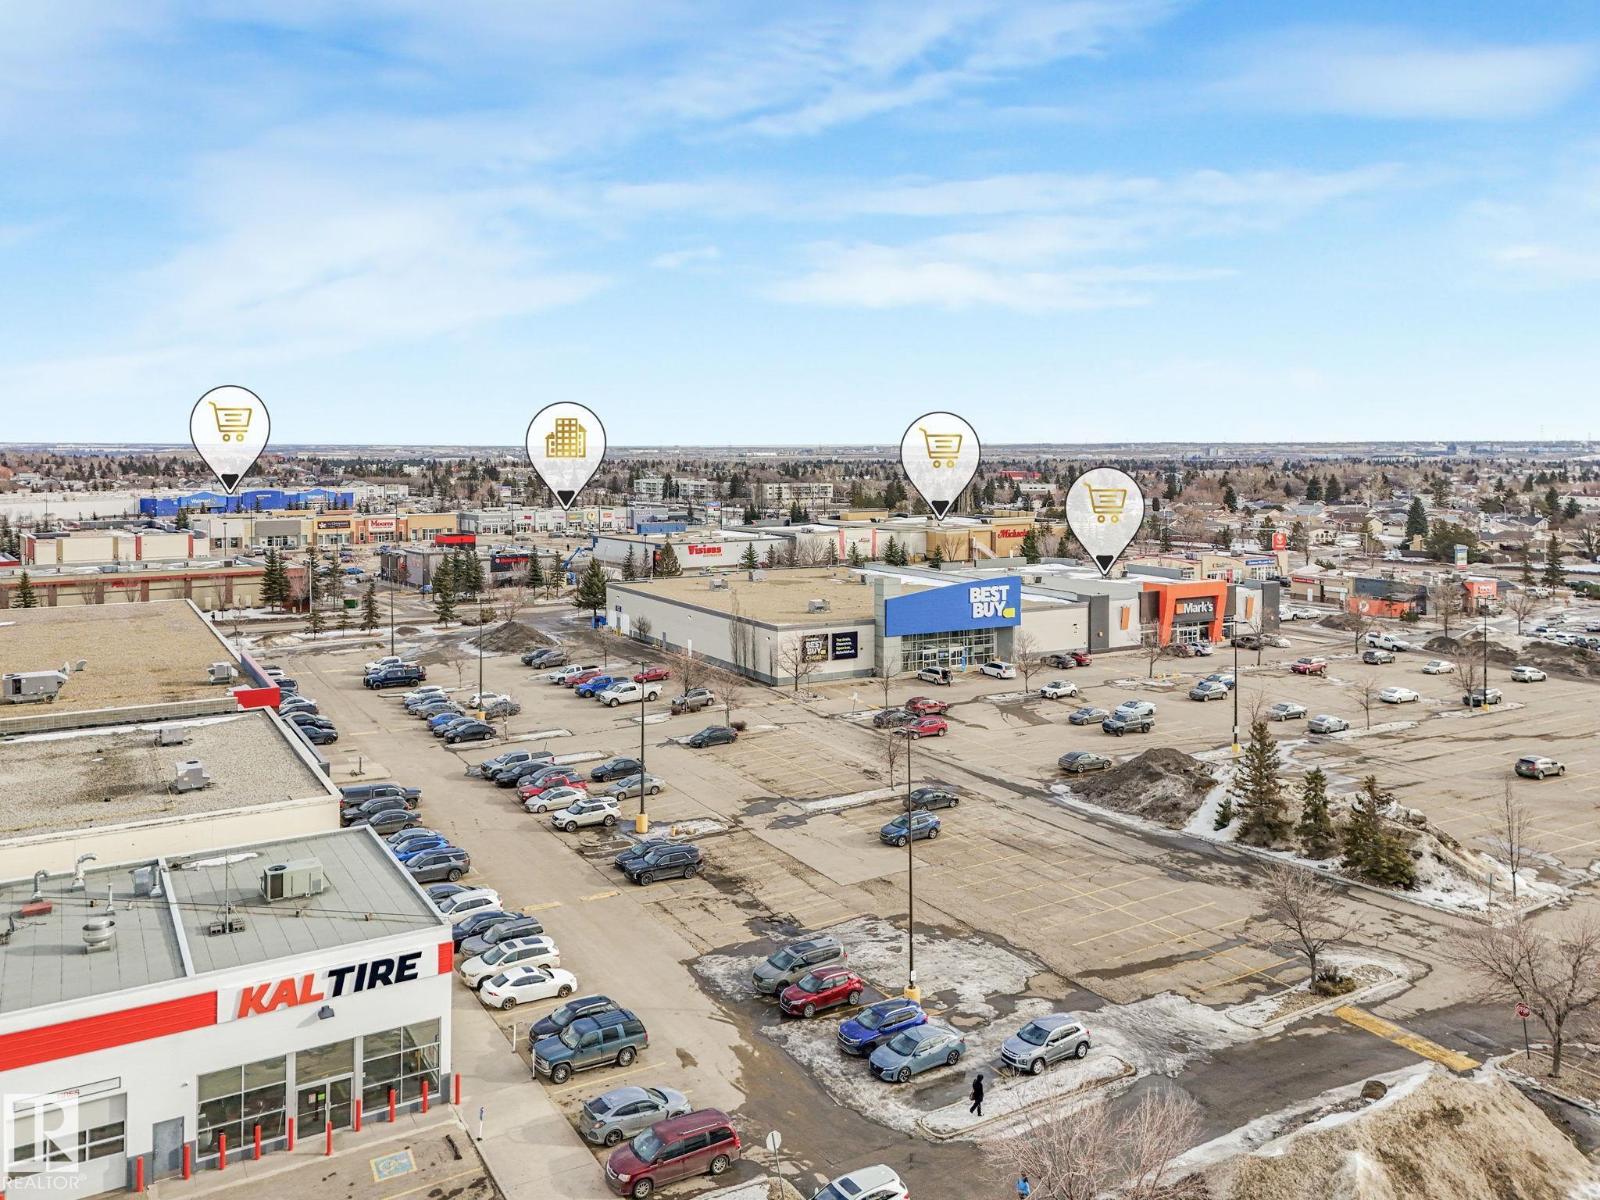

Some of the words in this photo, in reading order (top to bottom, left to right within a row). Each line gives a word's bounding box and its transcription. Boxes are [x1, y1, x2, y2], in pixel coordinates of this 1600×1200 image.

[969, 585, 1010, 603] BEST
[972, 601, 1006, 619] BUY
[1183, 602, 1214, 614] Mark's
[237, 973, 325, 1019] KAL
[327, 951, 423, 998] TIRE
